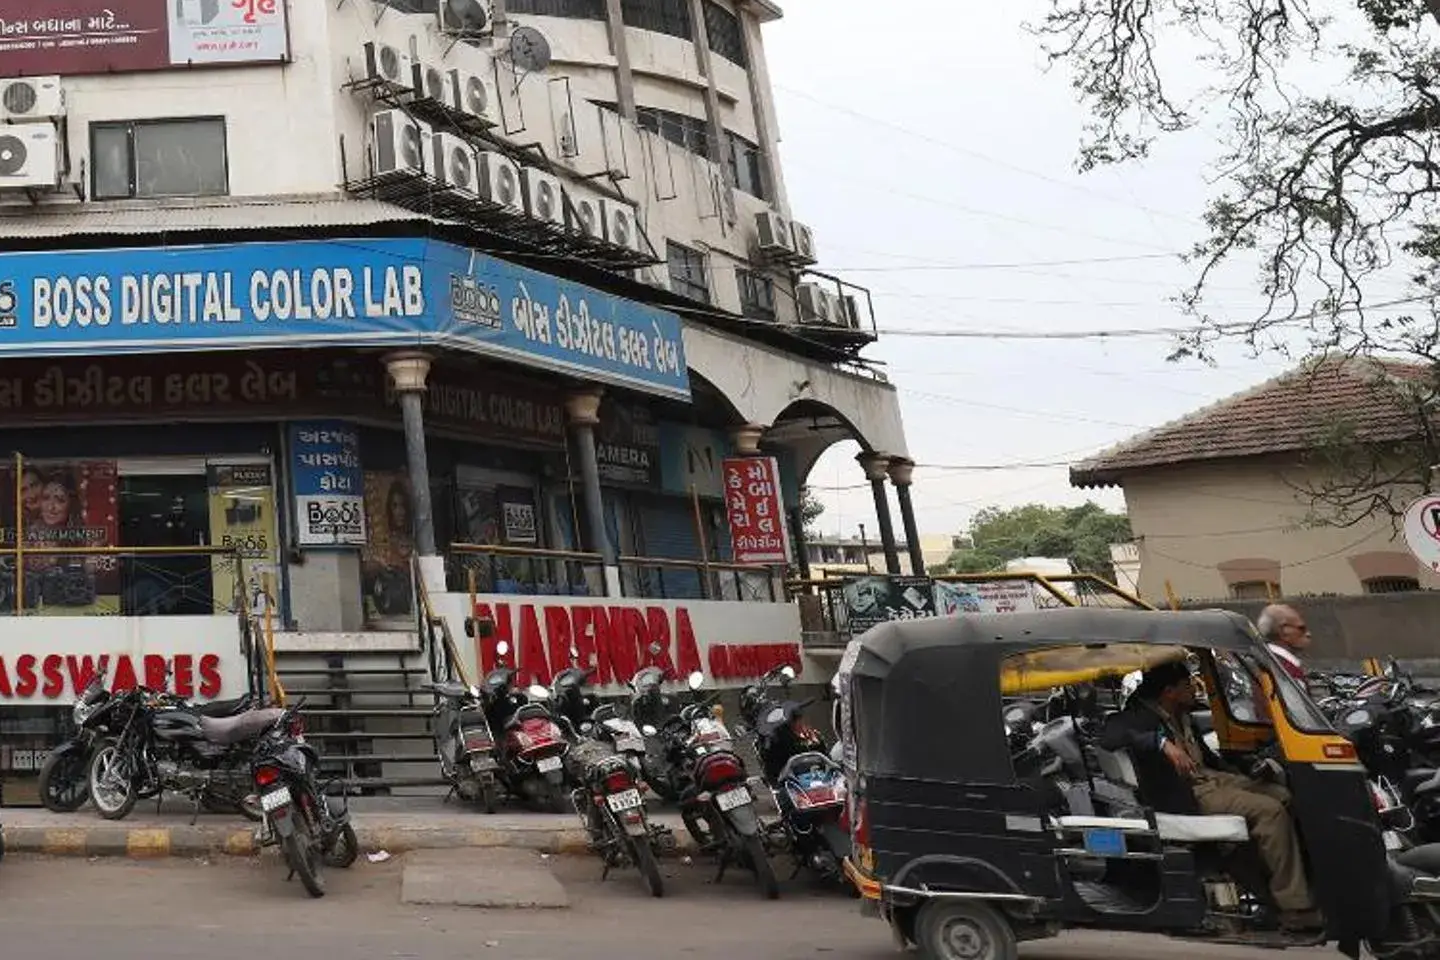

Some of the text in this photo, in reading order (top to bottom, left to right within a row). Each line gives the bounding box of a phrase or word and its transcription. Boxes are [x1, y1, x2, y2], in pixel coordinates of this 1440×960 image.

[33, 265, 424, 328] BOSS DIGITAL COLOR LAB
[512, 280, 681, 377] બોસ ડીઝીટલ કલર લેબ
[33, 365, 153, 407] ડીઝીટલ
[164, 372, 230, 405] કલર
[240, 360, 296, 400] લેબ
[429, 383, 488, 422] DIGITAL
[597, 441, 650, 468] AMERA
